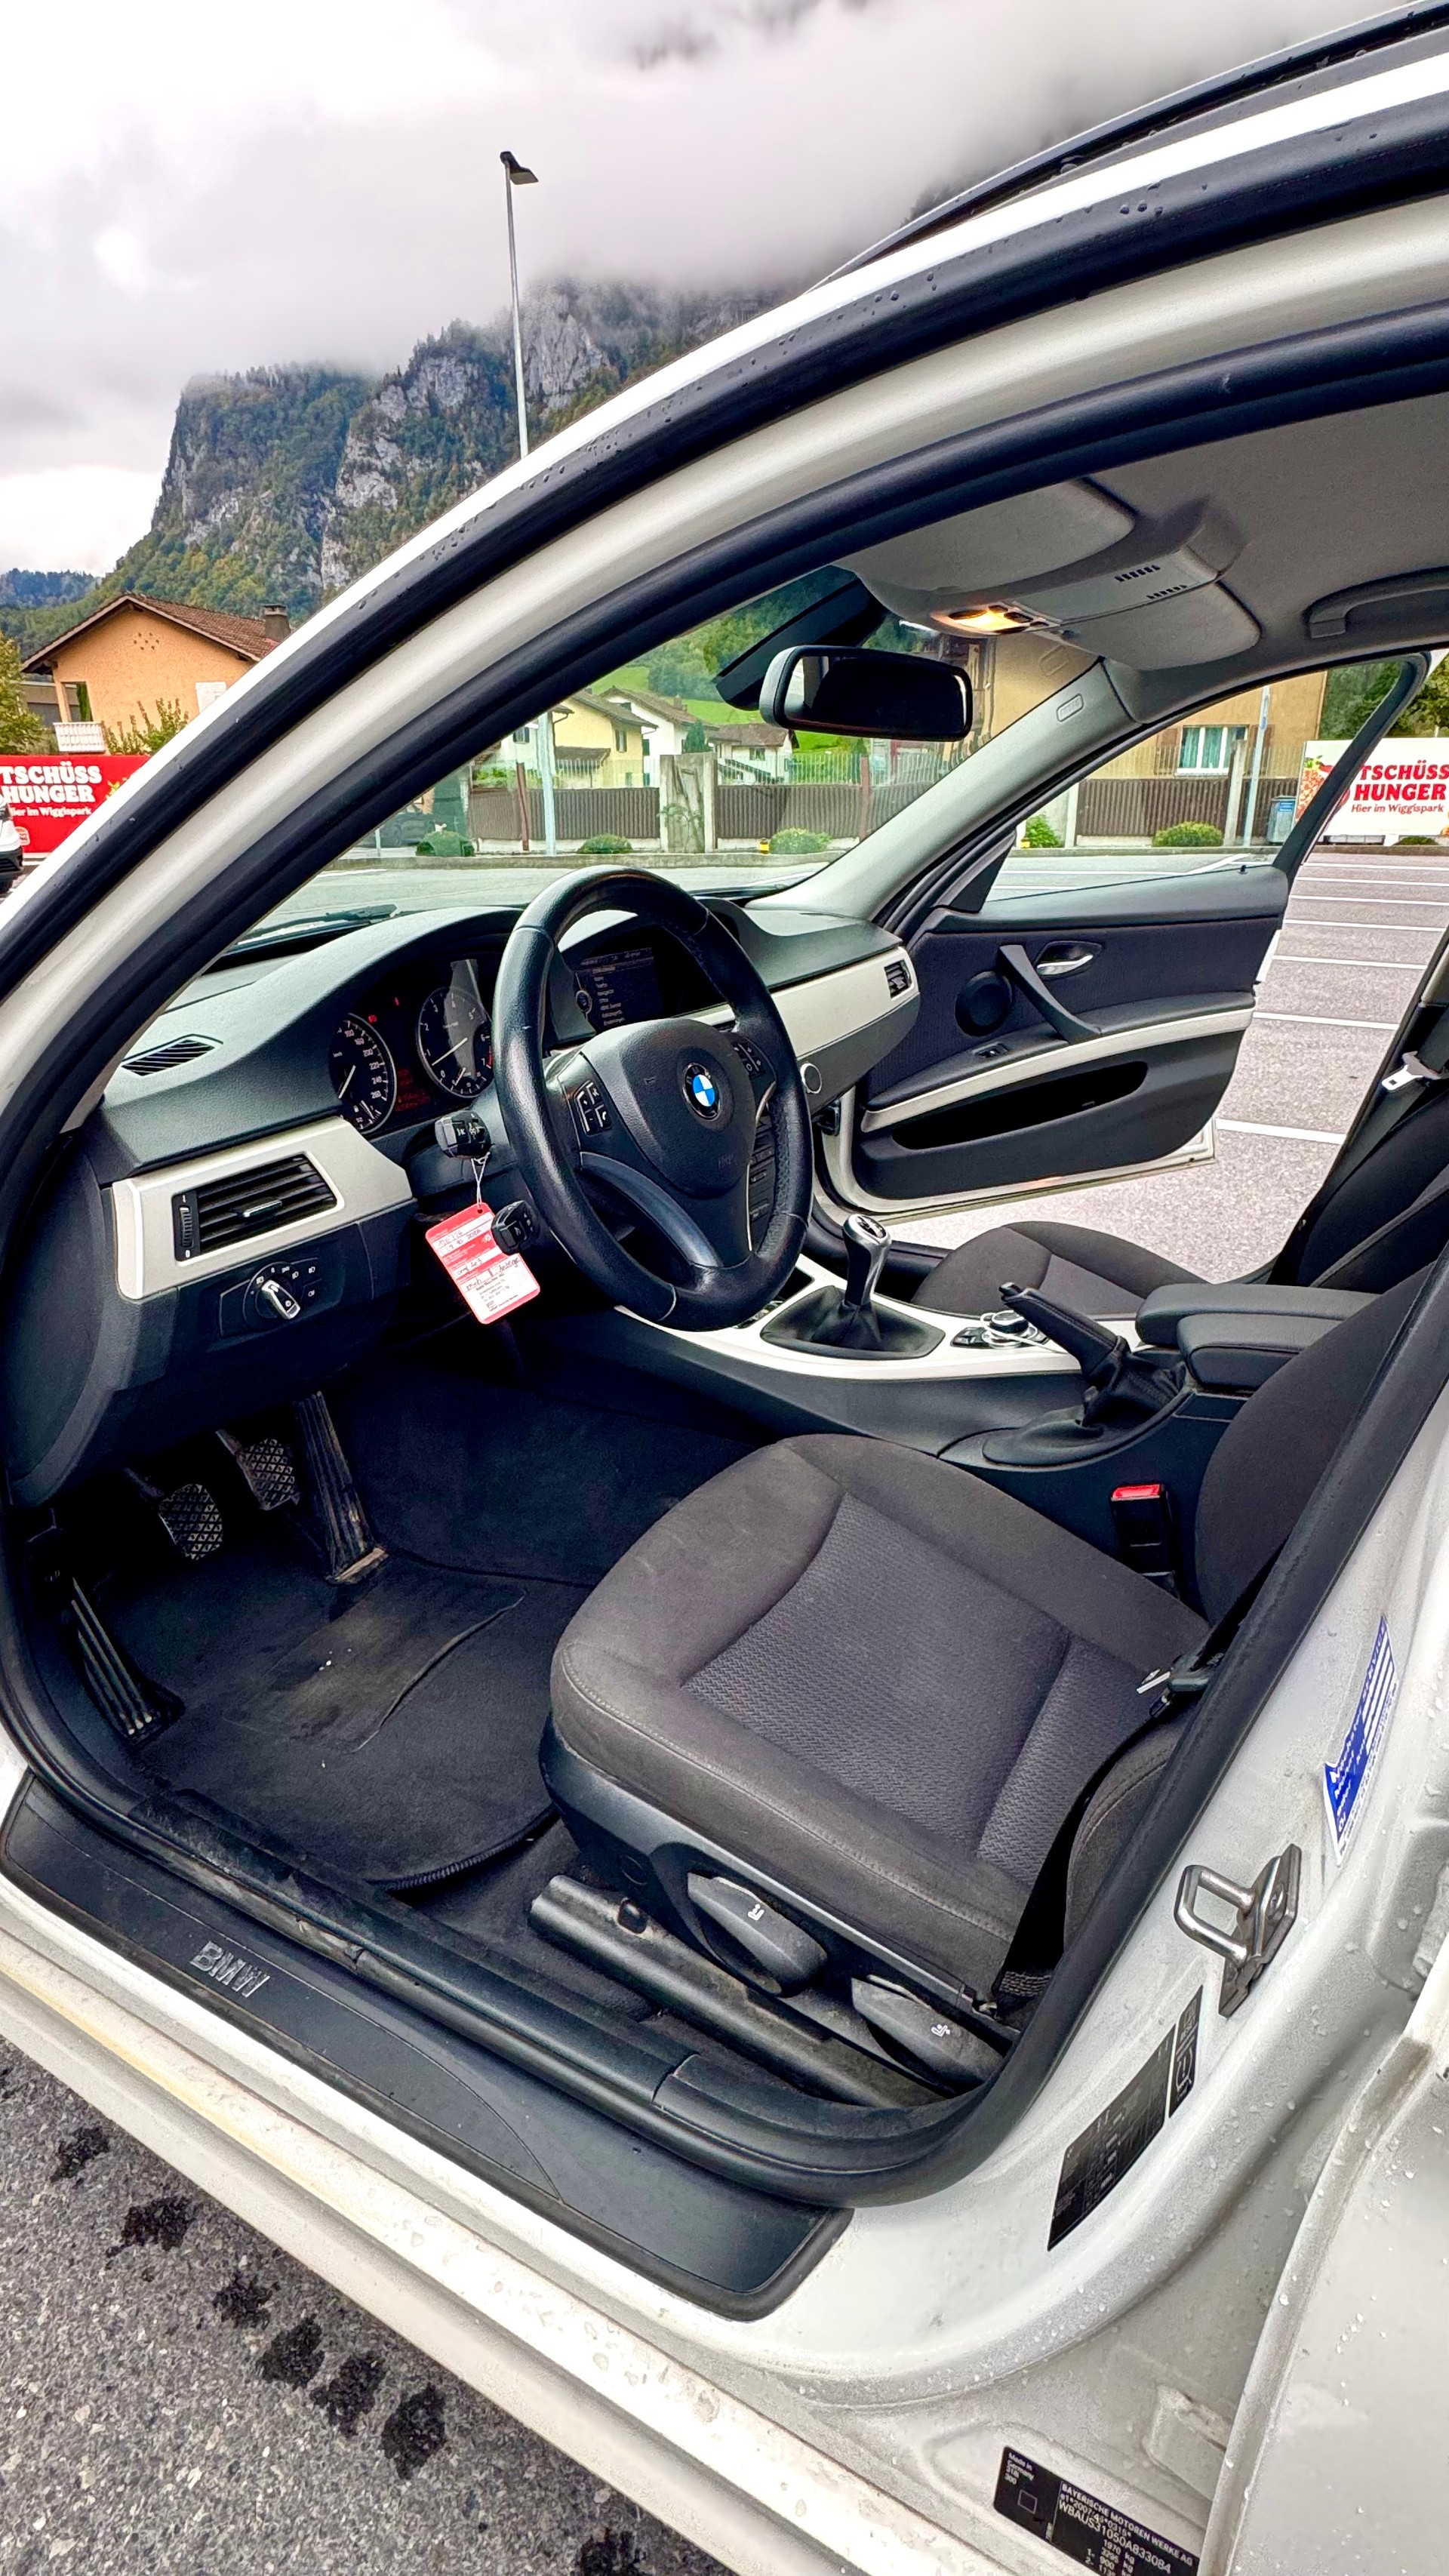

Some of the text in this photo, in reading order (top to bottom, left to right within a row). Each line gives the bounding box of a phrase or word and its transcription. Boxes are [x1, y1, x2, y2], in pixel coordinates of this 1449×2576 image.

[0, 761, 103, 784] TSCHÜSS
[1361, 759, 1449, 780] TSCHÜSS
[1, 785, 96, 803] HUNGER
[1353, 783, 1447, 801] HUNGER
[1351, 804, 1444, 815] Hier im Wiggispark
[189, 1940, 270, 1998] BMW
[1062, 2483, 1109, 2517] BAYERISCHE
[1110, 2511, 1150, 2541] MOTOREN
[1151, 2536, 1180, 2559] WERKE
[1103, 2539, 1135, 2565] 1970 kg
